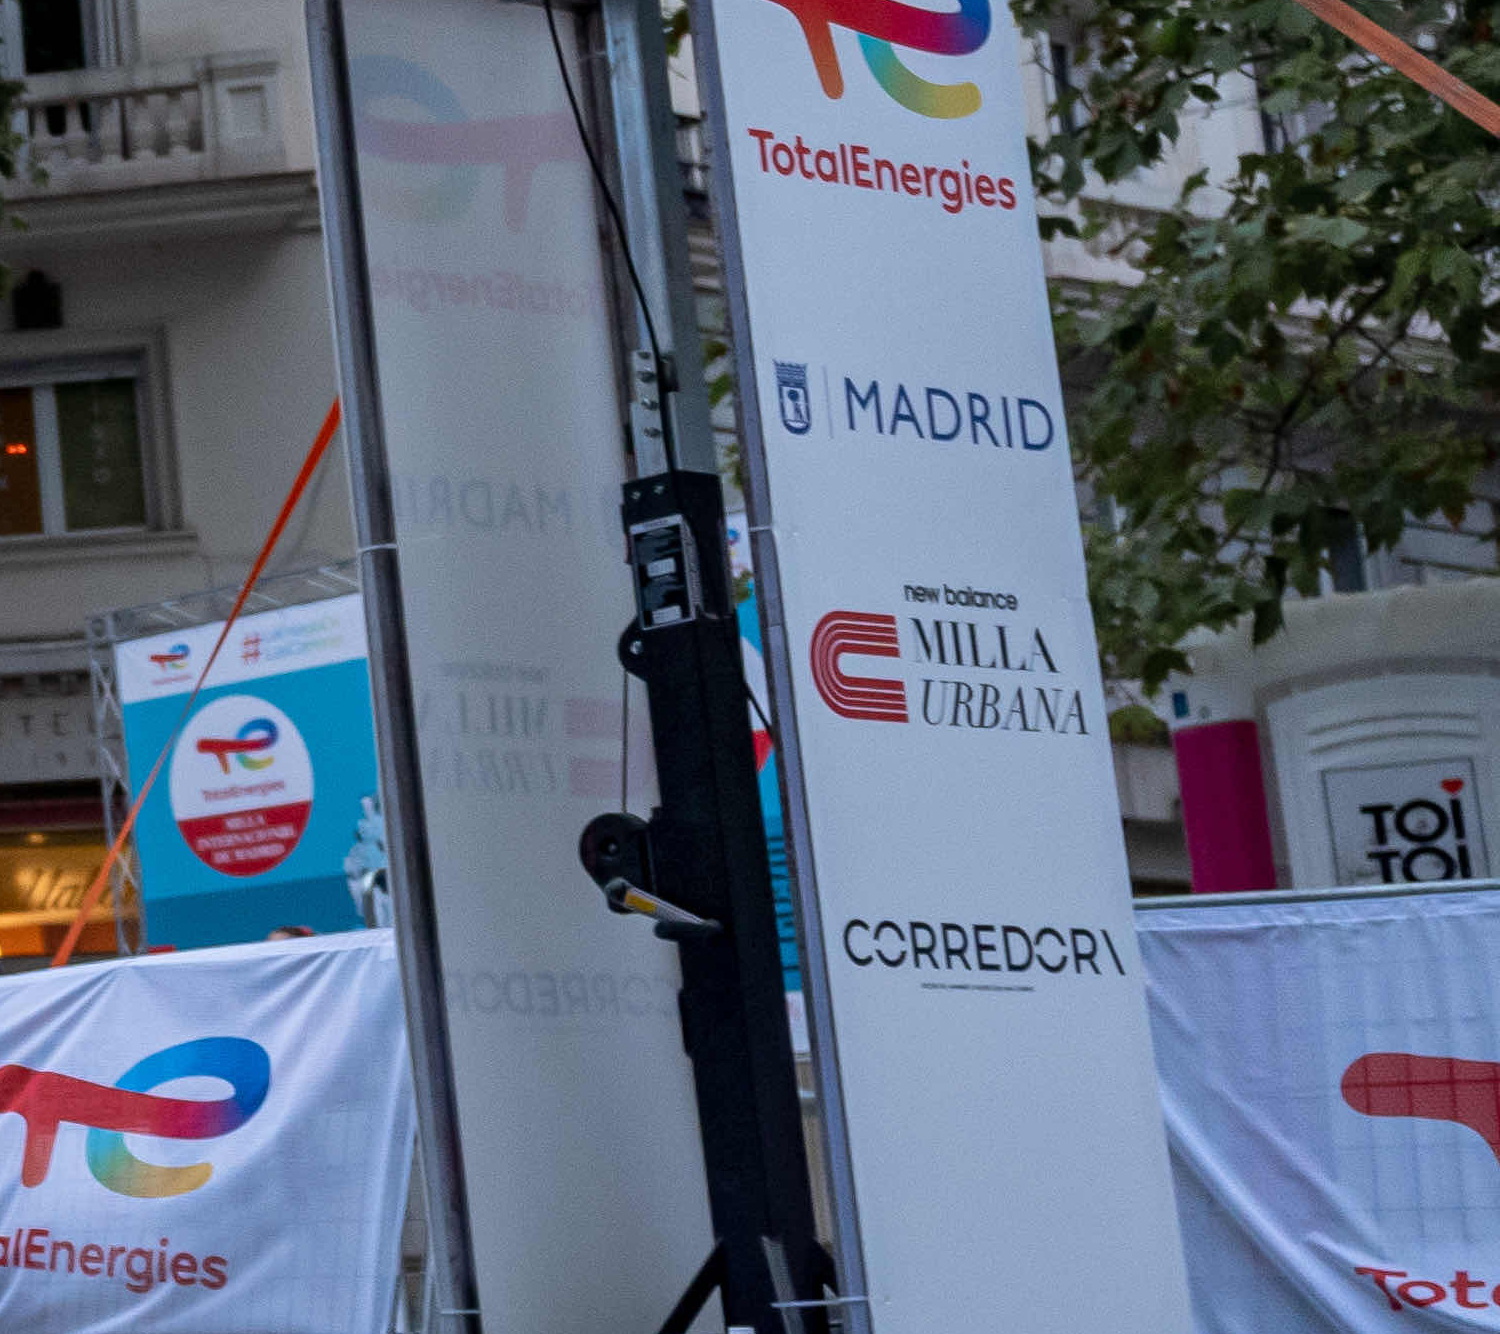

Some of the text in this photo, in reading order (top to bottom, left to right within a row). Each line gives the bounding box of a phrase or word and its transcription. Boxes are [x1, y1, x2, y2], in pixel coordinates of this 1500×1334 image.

[748, 128, 1016, 213] TotalEnergies
[844, 376, 1055, 451] MADRID
[904, 583, 1018, 612] new balance
[911, 618, 1061, 673] MILLA
[922, 678, 1089, 735] URBANA
